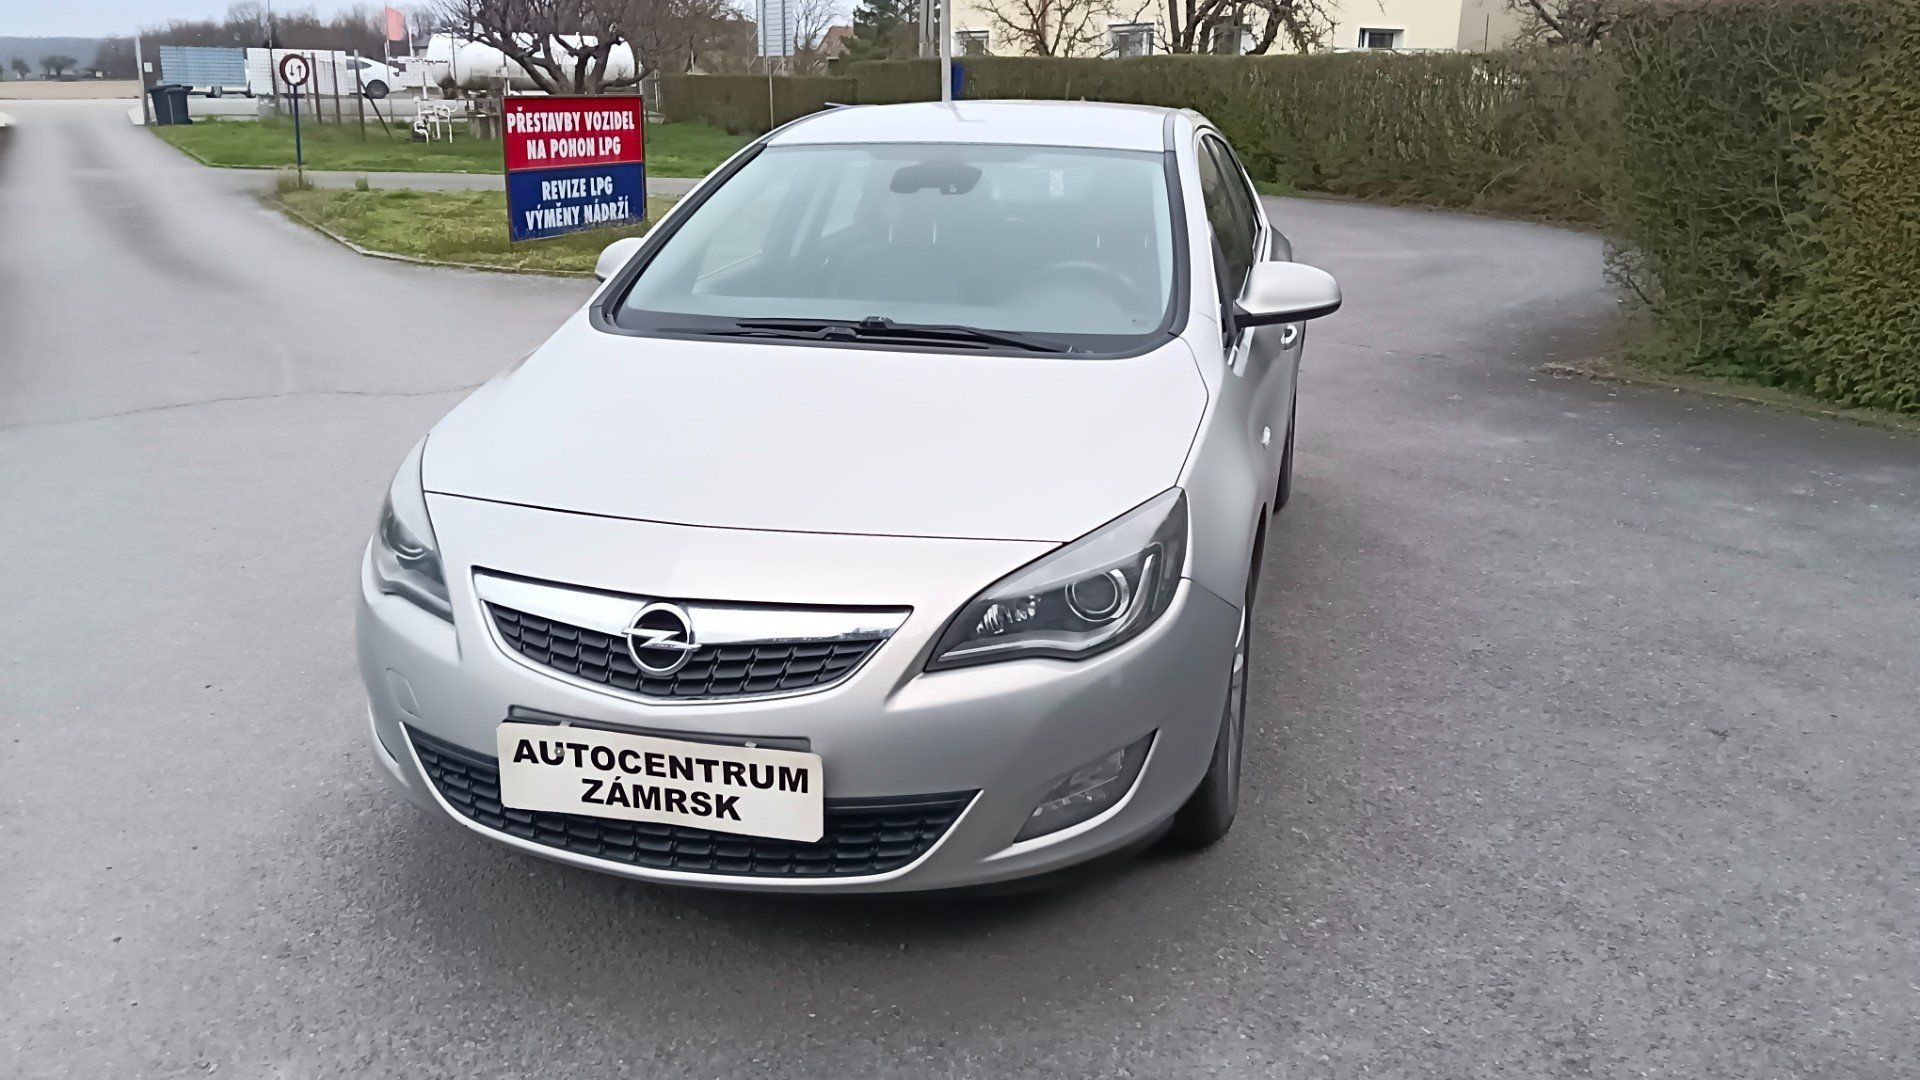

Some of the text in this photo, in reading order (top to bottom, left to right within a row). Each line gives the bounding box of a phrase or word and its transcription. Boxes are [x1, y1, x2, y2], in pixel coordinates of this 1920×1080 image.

[507, 106, 634, 132] PŘESTAVBY VOZIDEL
[527, 136, 620, 159] NA POHON LPG
[541, 176, 612, 200] REVIZE LPG
[525, 196, 628, 230] VÝMĚNY NÁDRŽÍ
[513, 738, 809, 794] AUTOCENTRUM
[581, 776, 742, 821] ZÁMRSK
